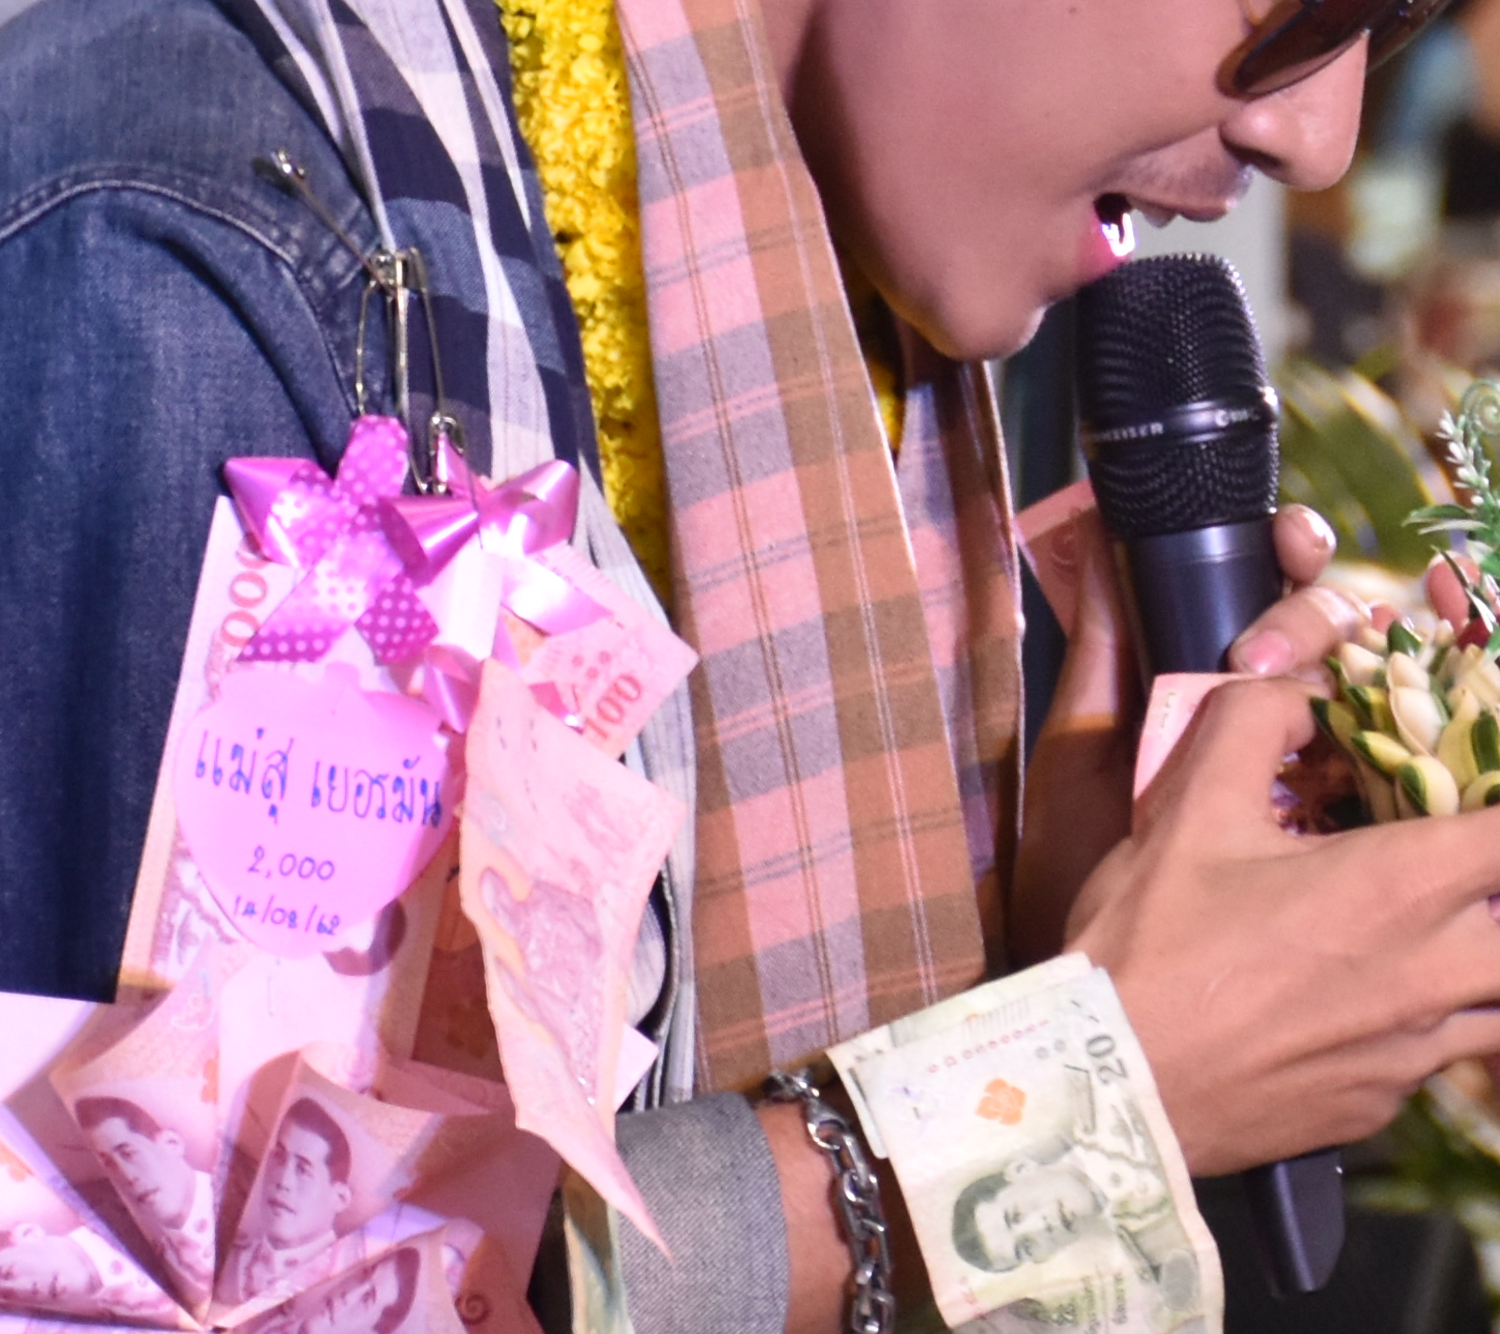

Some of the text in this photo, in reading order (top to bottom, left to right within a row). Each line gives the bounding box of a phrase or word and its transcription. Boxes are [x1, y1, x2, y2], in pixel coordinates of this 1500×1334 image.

[584, 673, 642, 741] 100
[311, 755, 443, 829] เยอรมัน
[248, 844, 335, 882] 2,000
[1085, 1033, 1128, 1085] 20
